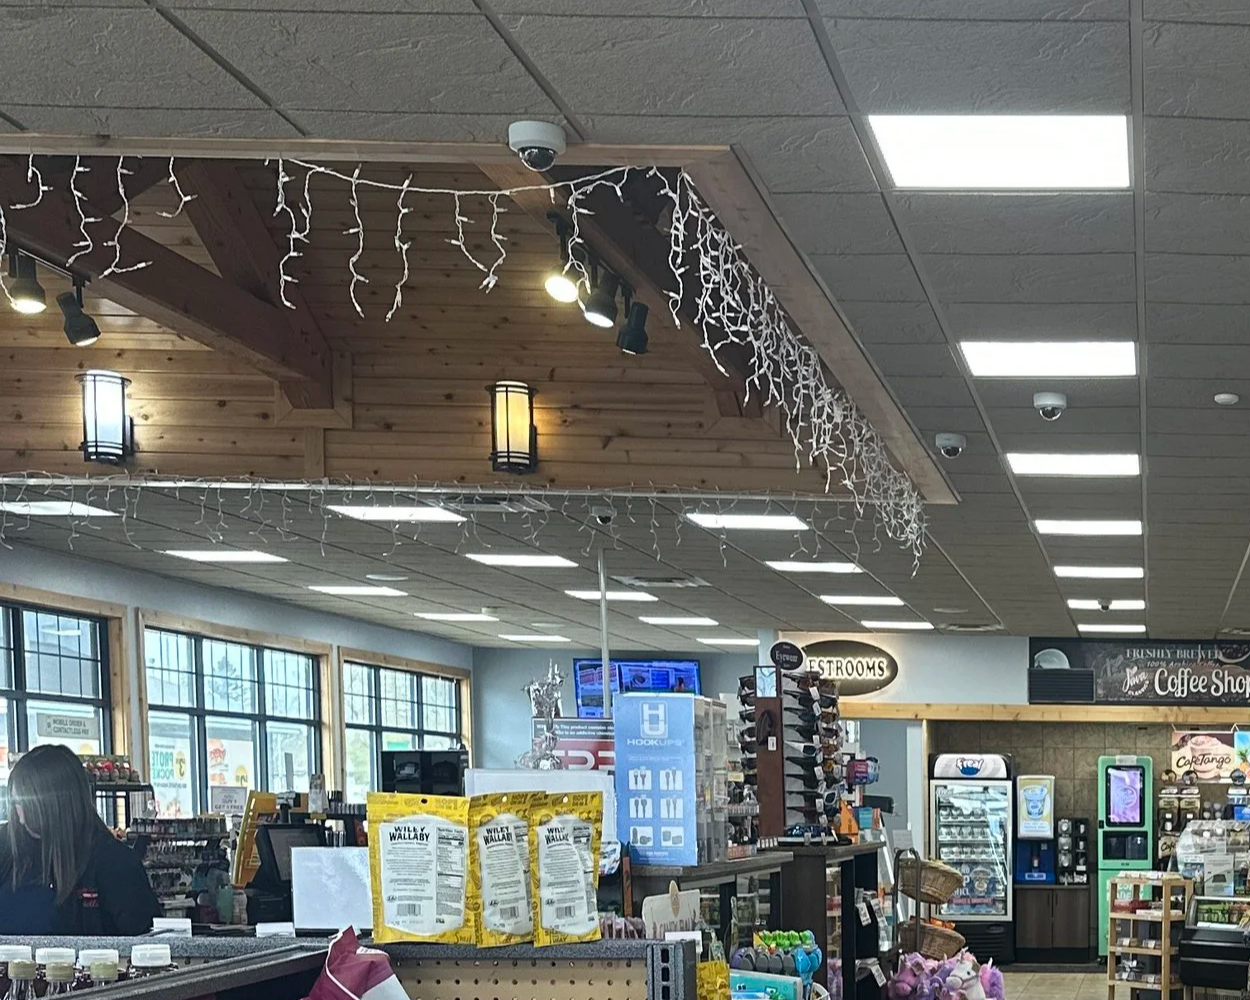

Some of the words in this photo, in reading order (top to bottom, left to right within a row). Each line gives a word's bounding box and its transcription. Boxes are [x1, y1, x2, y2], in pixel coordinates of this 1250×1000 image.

[1126, 648, 1172, 659] FRESHLY
[1176, 648, 1221, 659] BREWED
[808, 658, 886, 677] ESTROOMS
[1154, 668, 1208, 698] Coffee
[389, 832, 430, 842] WALLABY
